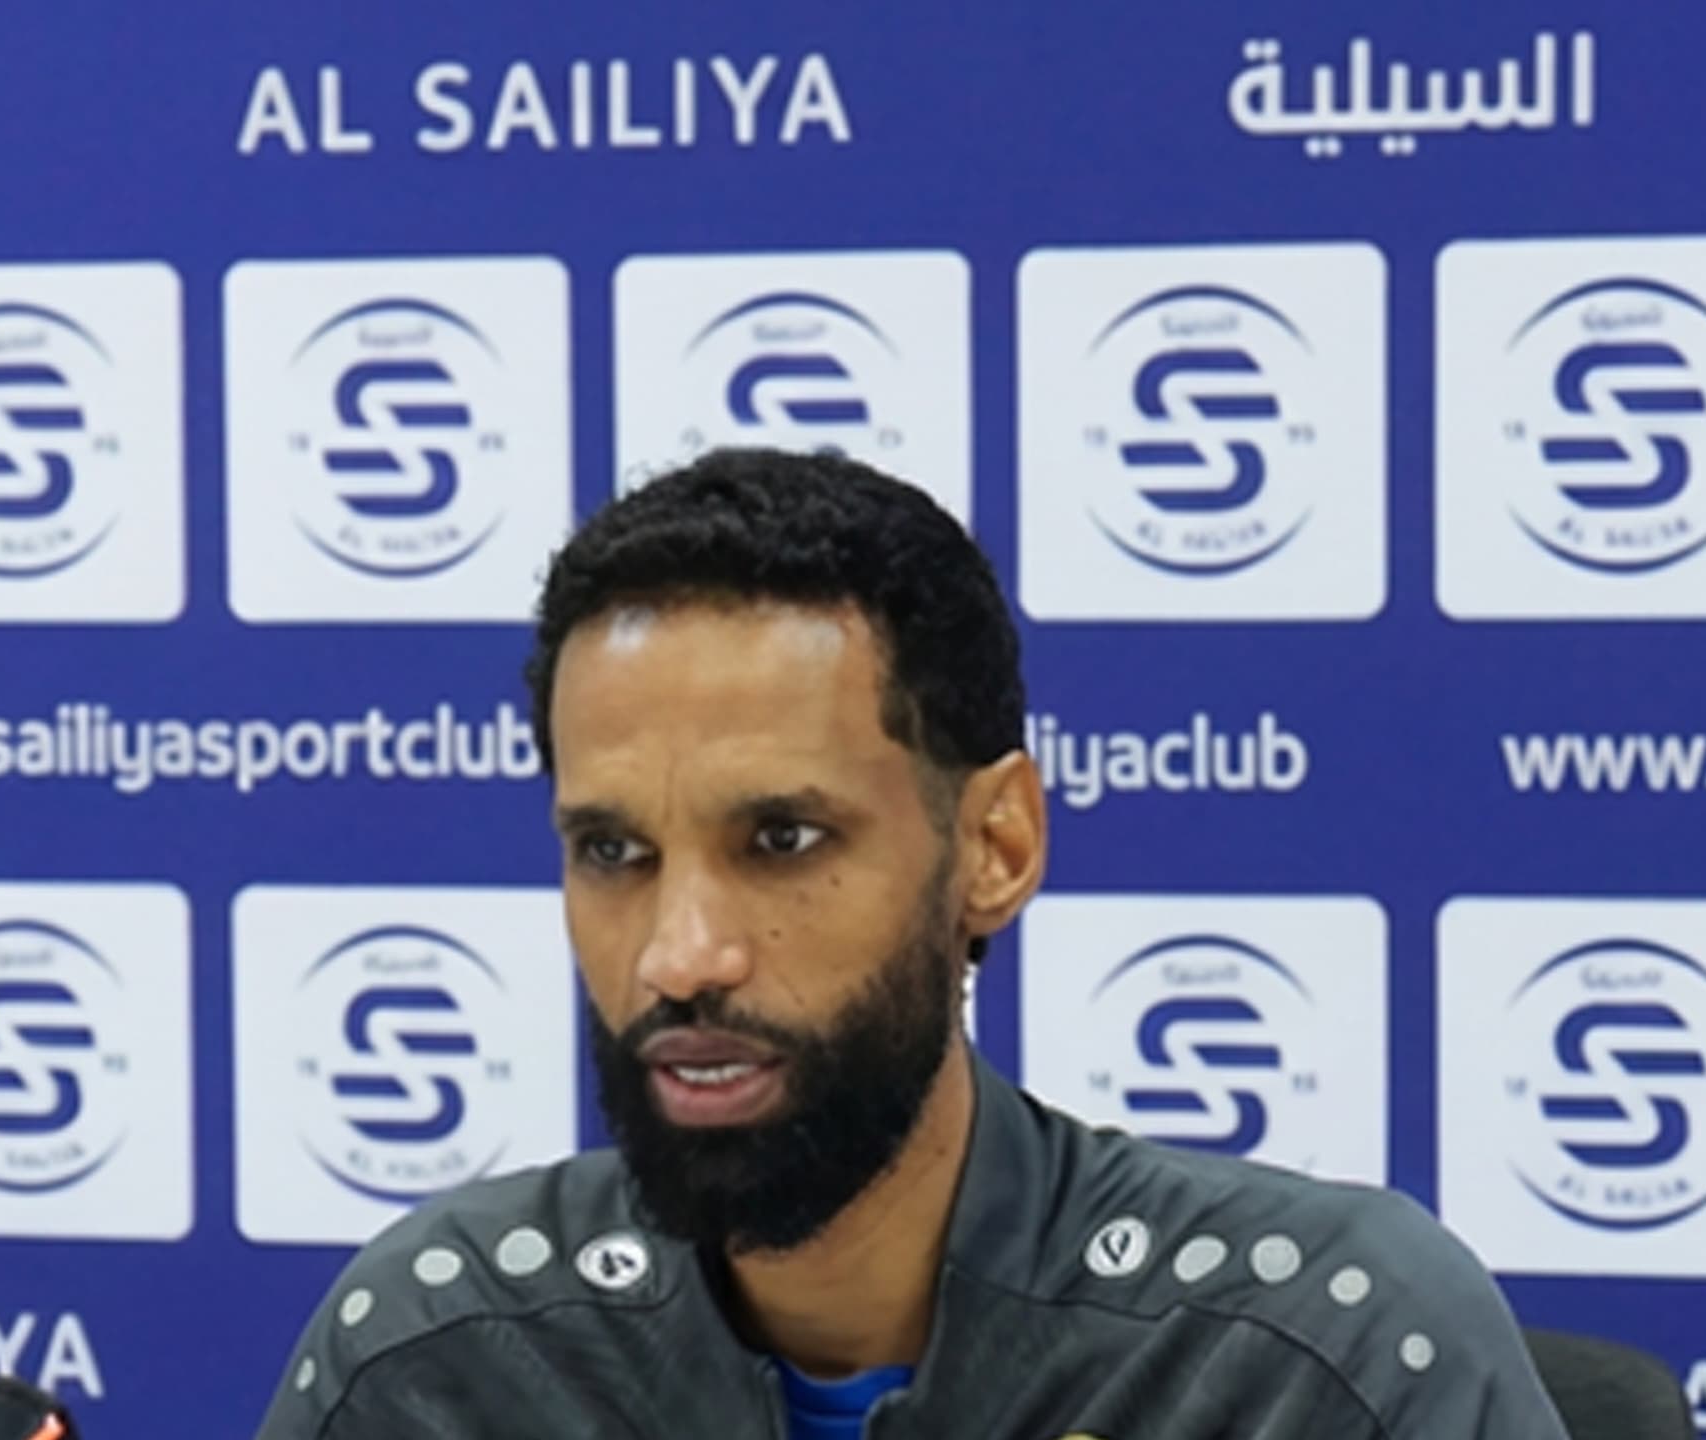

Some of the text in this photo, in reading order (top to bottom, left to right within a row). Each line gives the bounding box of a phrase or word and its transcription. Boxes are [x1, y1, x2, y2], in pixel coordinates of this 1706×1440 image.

[238, 54, 851, 154] AL SAILIYA
[1228, 32, 1594, 157] السيلية
